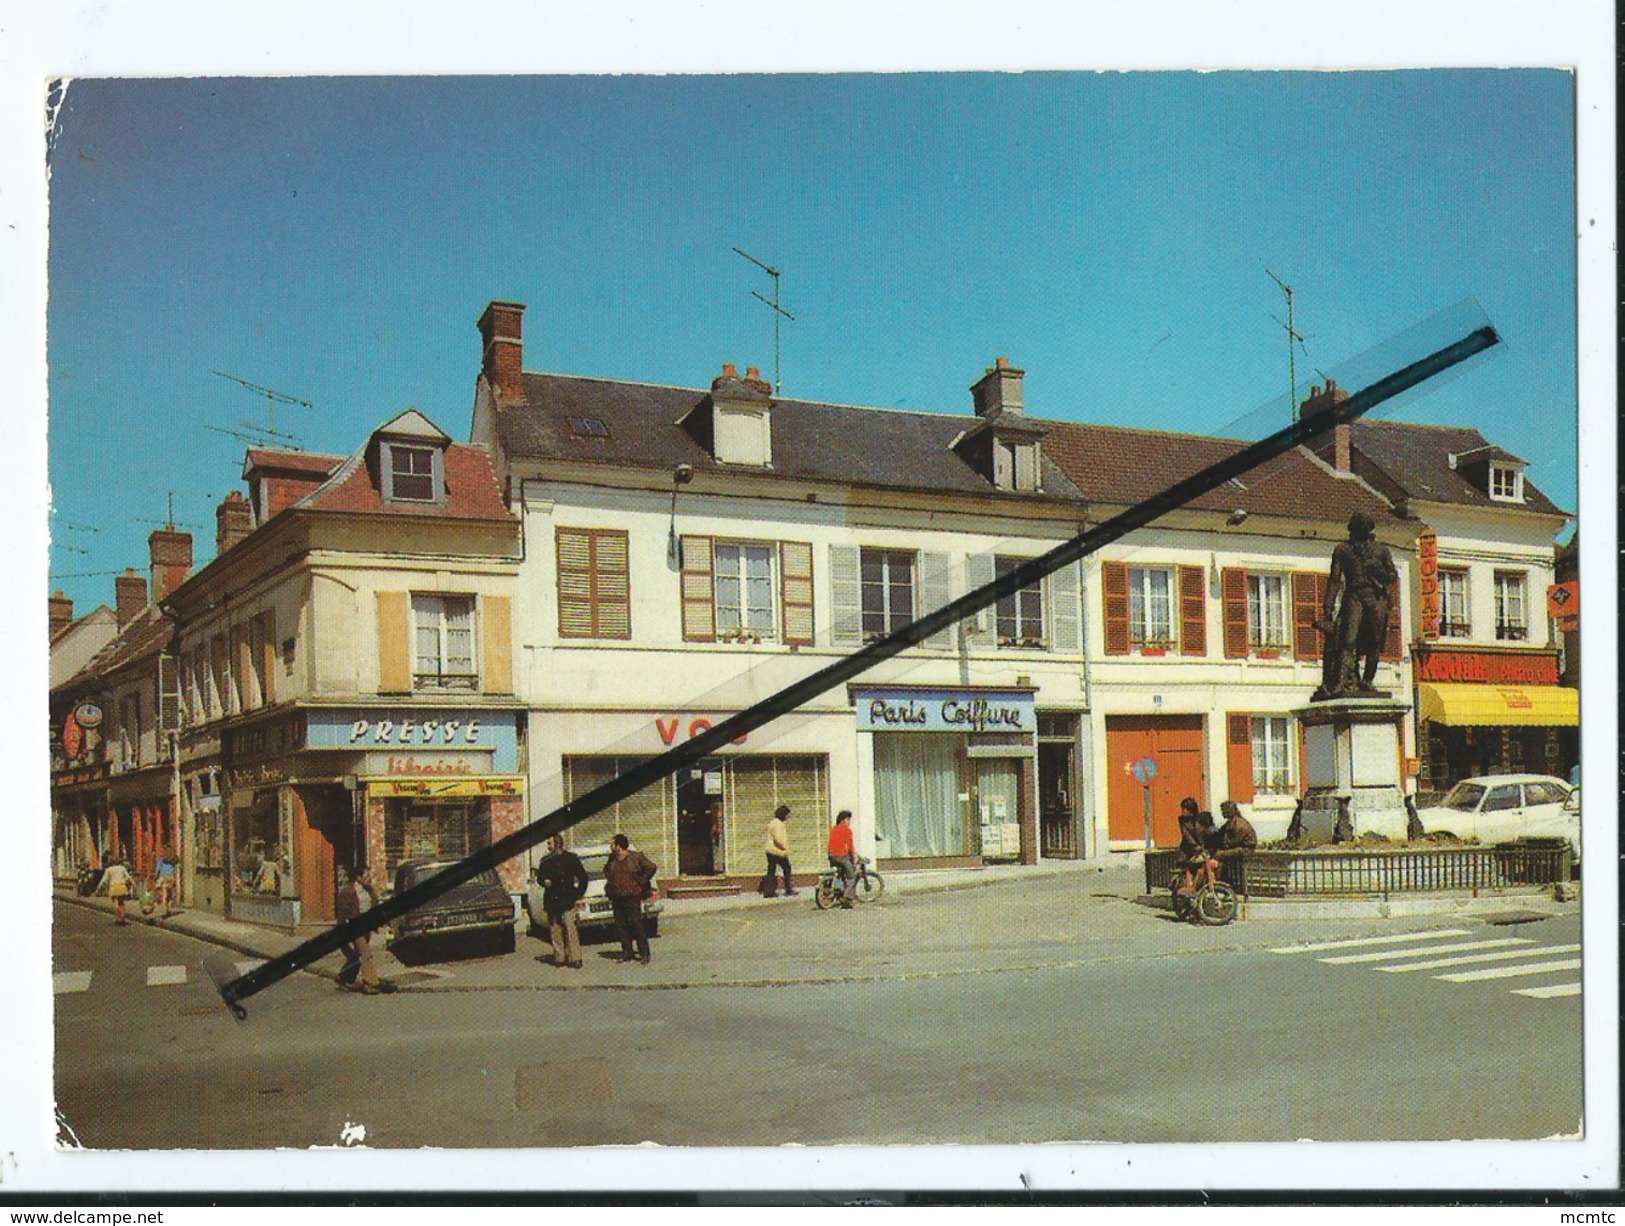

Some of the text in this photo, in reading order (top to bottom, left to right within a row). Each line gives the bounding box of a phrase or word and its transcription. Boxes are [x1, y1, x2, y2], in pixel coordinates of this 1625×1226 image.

[870, 698, 1023, 731] Paris Coiffure
[350, 719, 481, 743] PRESSE
[656, 719, 748, 746] VO
